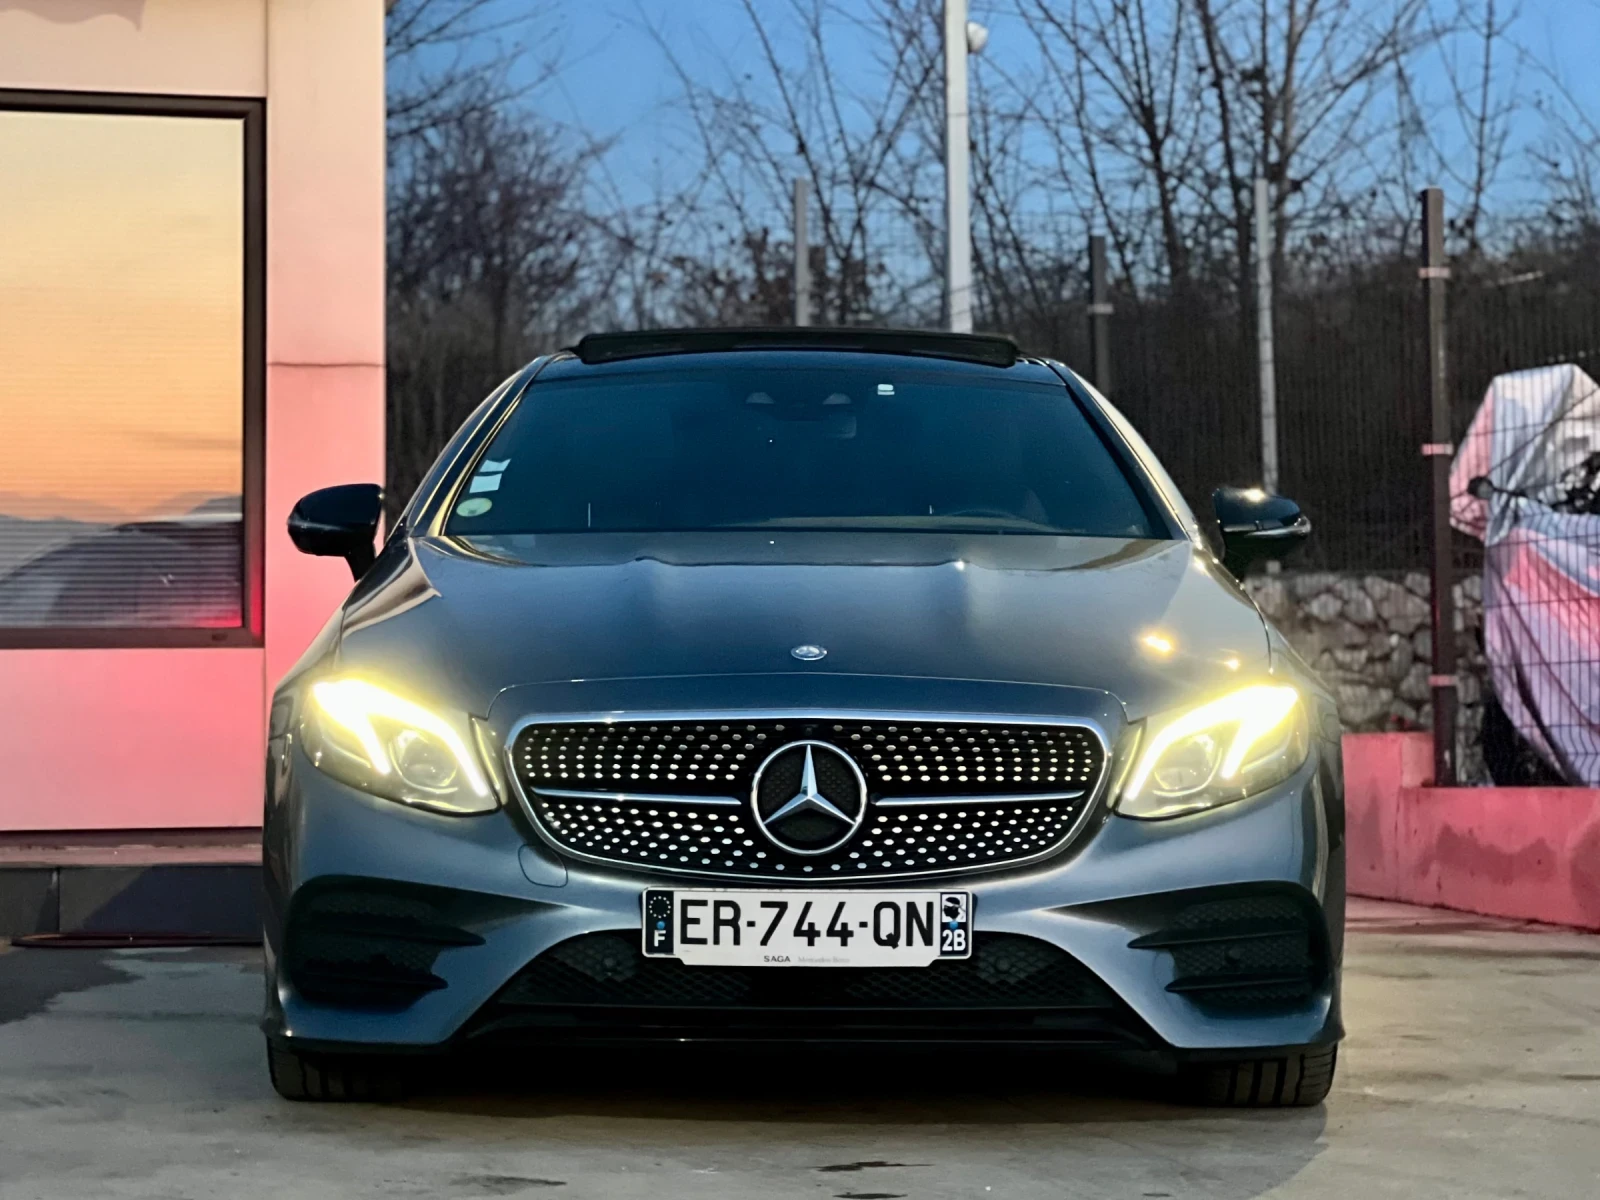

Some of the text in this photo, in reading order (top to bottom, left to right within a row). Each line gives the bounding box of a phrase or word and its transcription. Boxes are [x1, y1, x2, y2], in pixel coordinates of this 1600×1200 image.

[680, 899, 934, 949] ER-744-QN
[653, 929, 667, 947] F
[942, 929, 966, 951] 2B
[763, 955, 791, 963] SAGA
